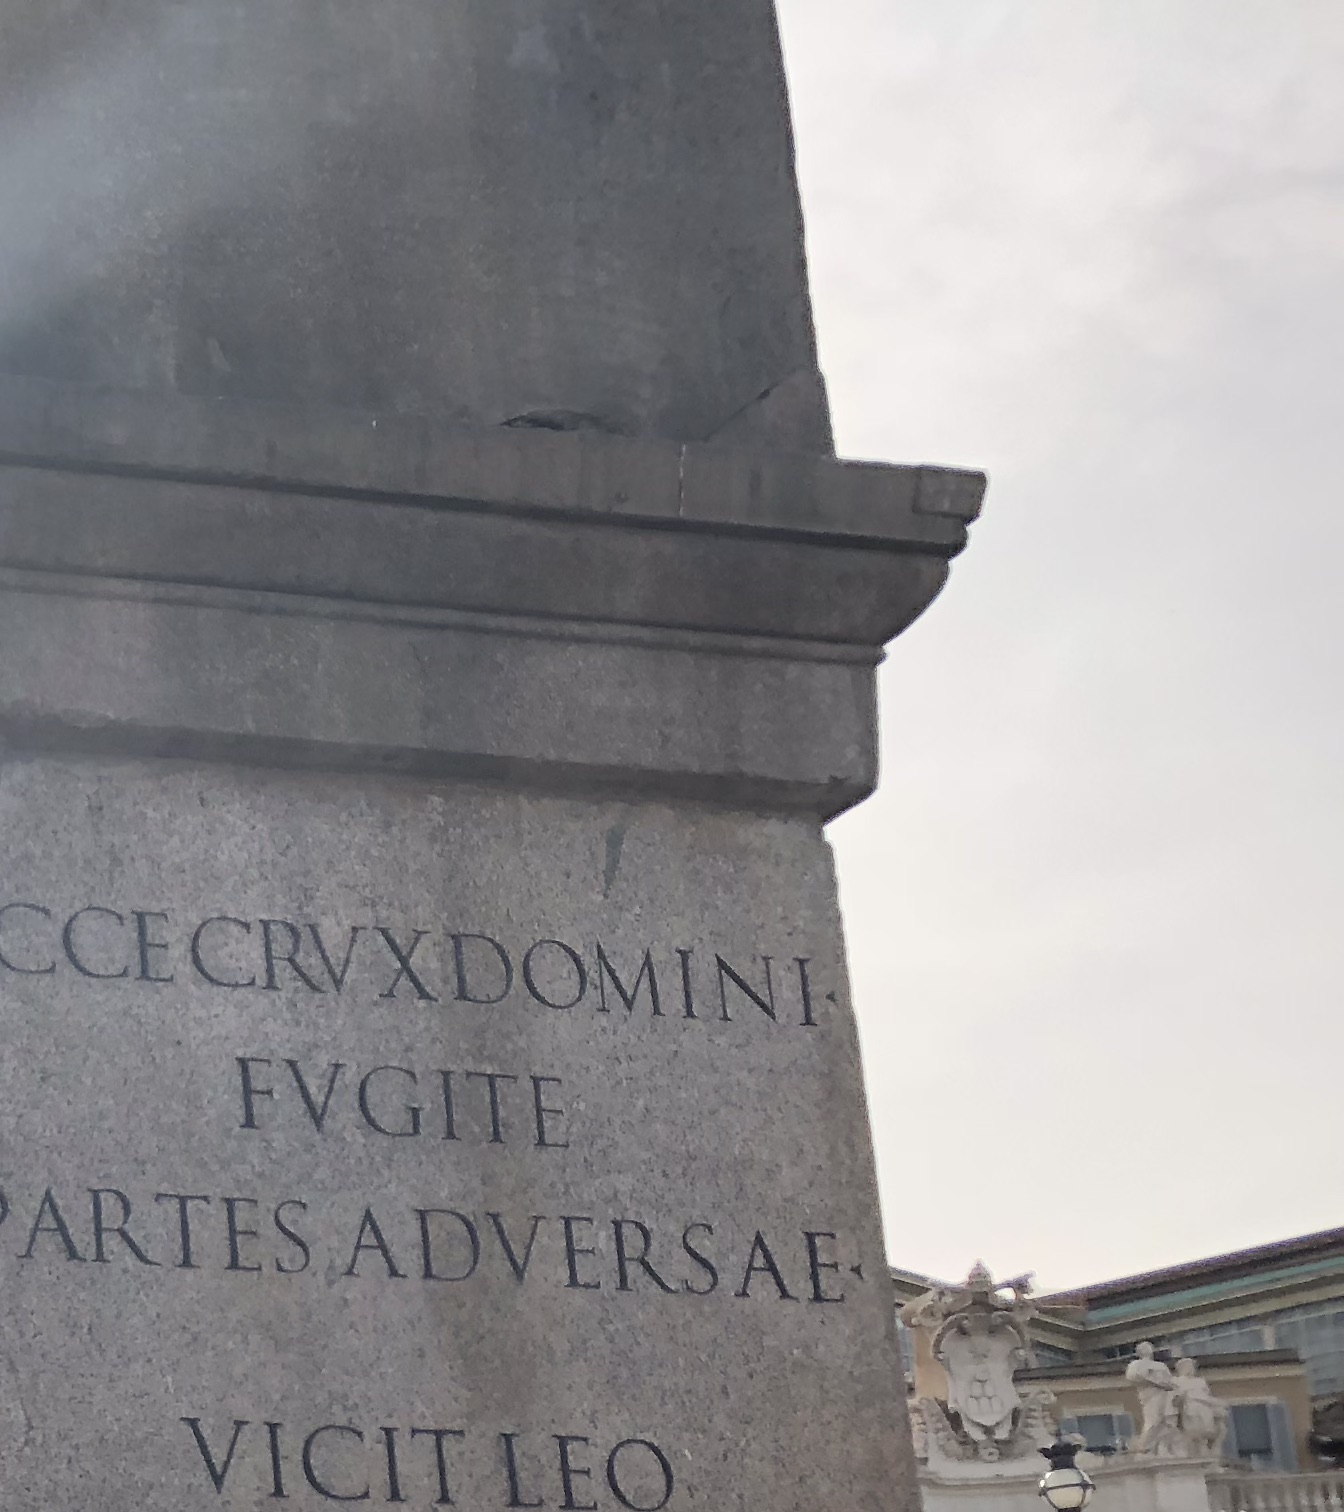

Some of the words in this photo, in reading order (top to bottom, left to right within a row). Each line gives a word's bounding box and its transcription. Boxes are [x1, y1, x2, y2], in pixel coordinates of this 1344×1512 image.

[191, 916, 439, 1002] CRVX
[235, 1056, 570, 1148] FVGITE
[180, 1417, 466, 1505] VICIT
[499, 1431, 674, 1512] LEO
